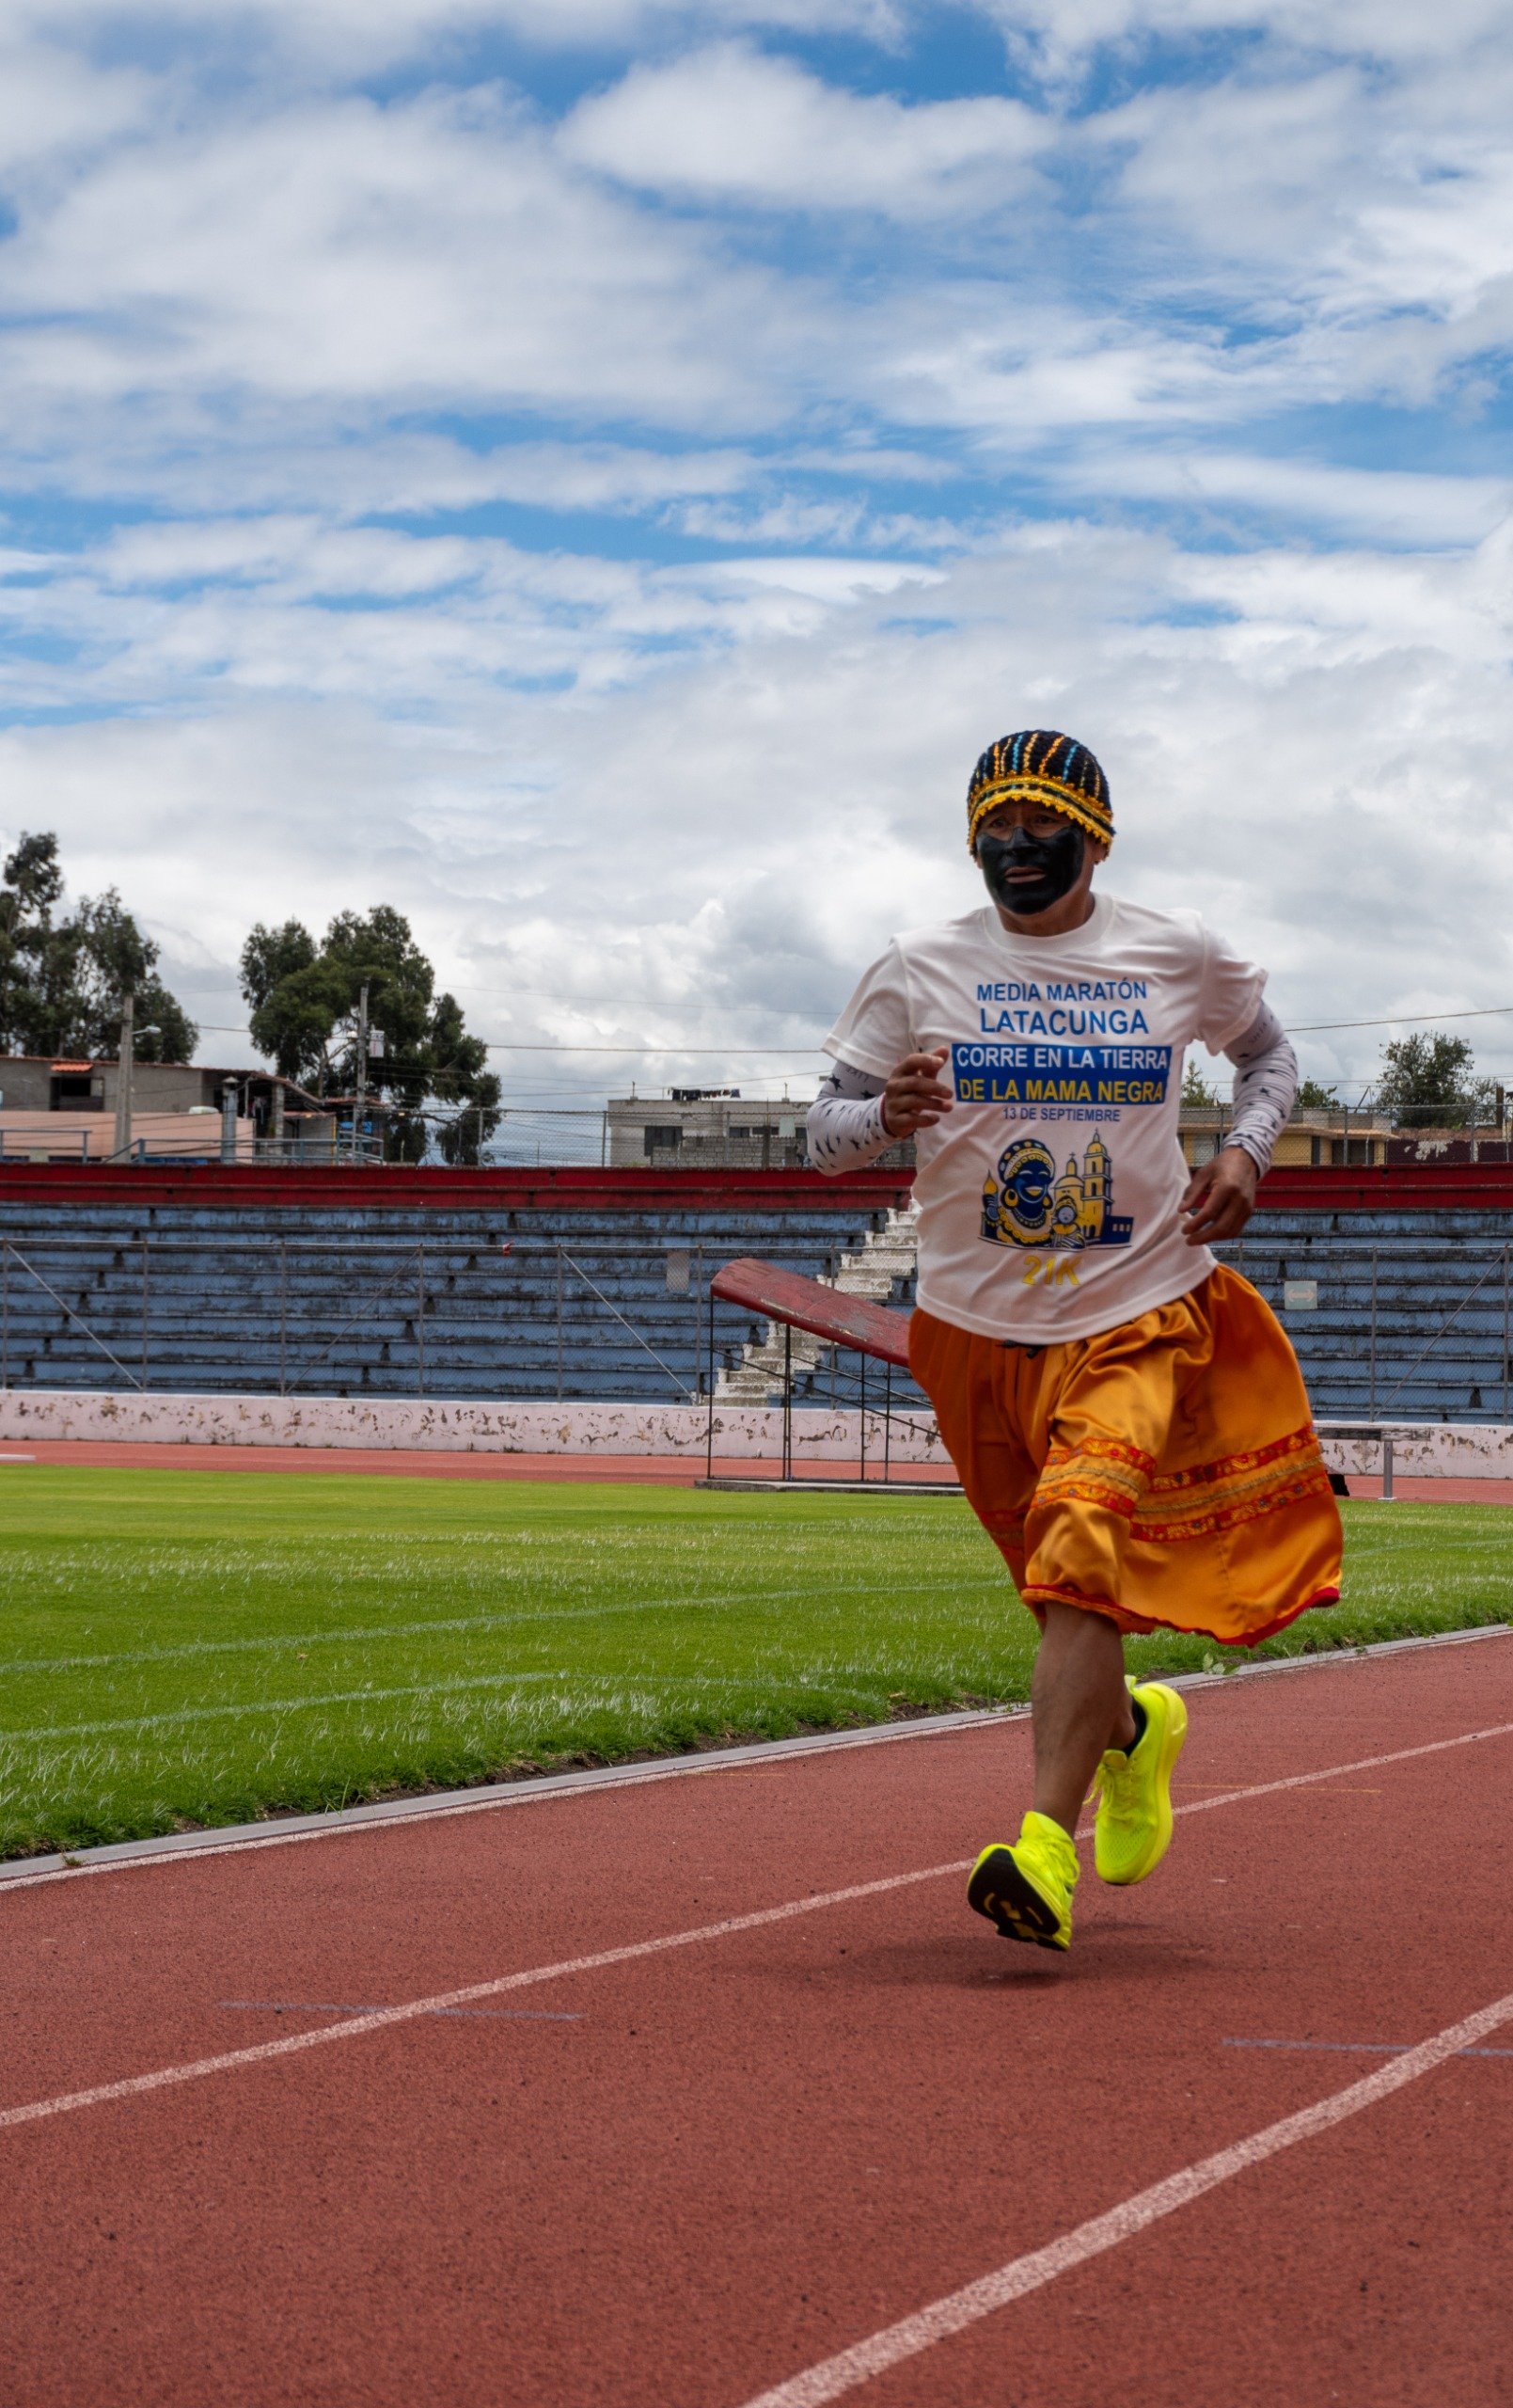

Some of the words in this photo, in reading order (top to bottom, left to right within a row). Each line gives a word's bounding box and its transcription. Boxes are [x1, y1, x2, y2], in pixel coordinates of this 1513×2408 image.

[977, 983, 1042, 1002] MEDIA
[1047, 977, 1147, 1002] MARATÓN
[980, 1008, 1149, 1036] LATACUNGA
[956, 1046, 1028, 1068] CORRE
[1034, 1048, 1062, 1069] EN
[1068, 1049, 1095, 1069] LA
[1099, 1049, 1168, 1069] TIERRA
[959, 1078, 985, 1100] DE
[992, 1079, 1019, 1101] LA
[1025, 1080, 1093, 1101] MAMA
[1097, 1081, 1163, 1102] NEGRA
[1002, 1107, 1017, 1120] 13
[1020, 1107, 1036, 1120] DE
[1040, 1107, 1121, 1122] SEPTIEMBRE
[1022, 1255, 1081, 1286] 21K
